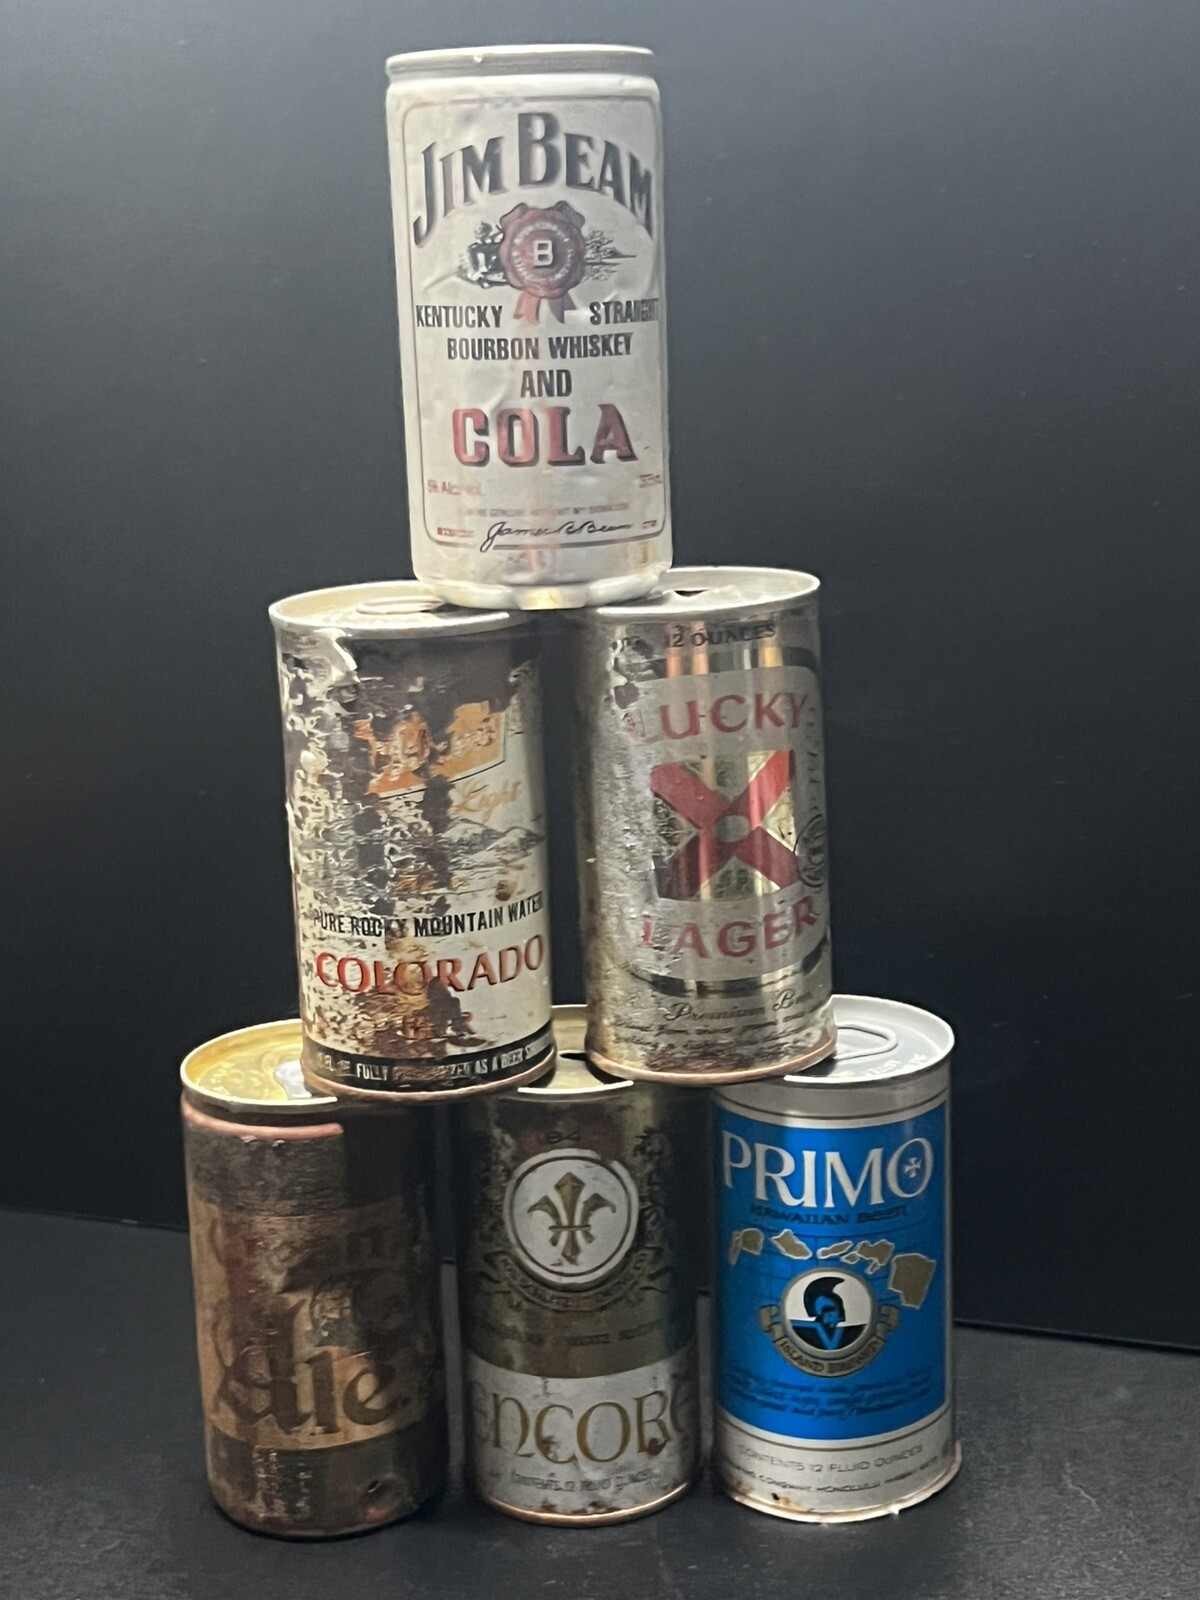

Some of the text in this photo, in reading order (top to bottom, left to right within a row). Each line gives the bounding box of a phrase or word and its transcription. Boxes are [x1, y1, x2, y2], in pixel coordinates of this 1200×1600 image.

[412, 112, 654, 248] JIM BEAM
[533, 240, 554, 268] B
[415, 304, 503, 328] KENTUCKY
[447, 332, 634, 361] BOURBON WHISKEY
[520, 369, 573, 398] AND
[452, 403, 639, 468] COLA
[640, 691, 808, 742] UCKY
[413, 906, 504, 938] MOUNTAIN
[641, 895, 819, 960] LAGER
[315, 933, 545, 996] COLORADO
[721, 1130, 935, 1208] PRIMO
